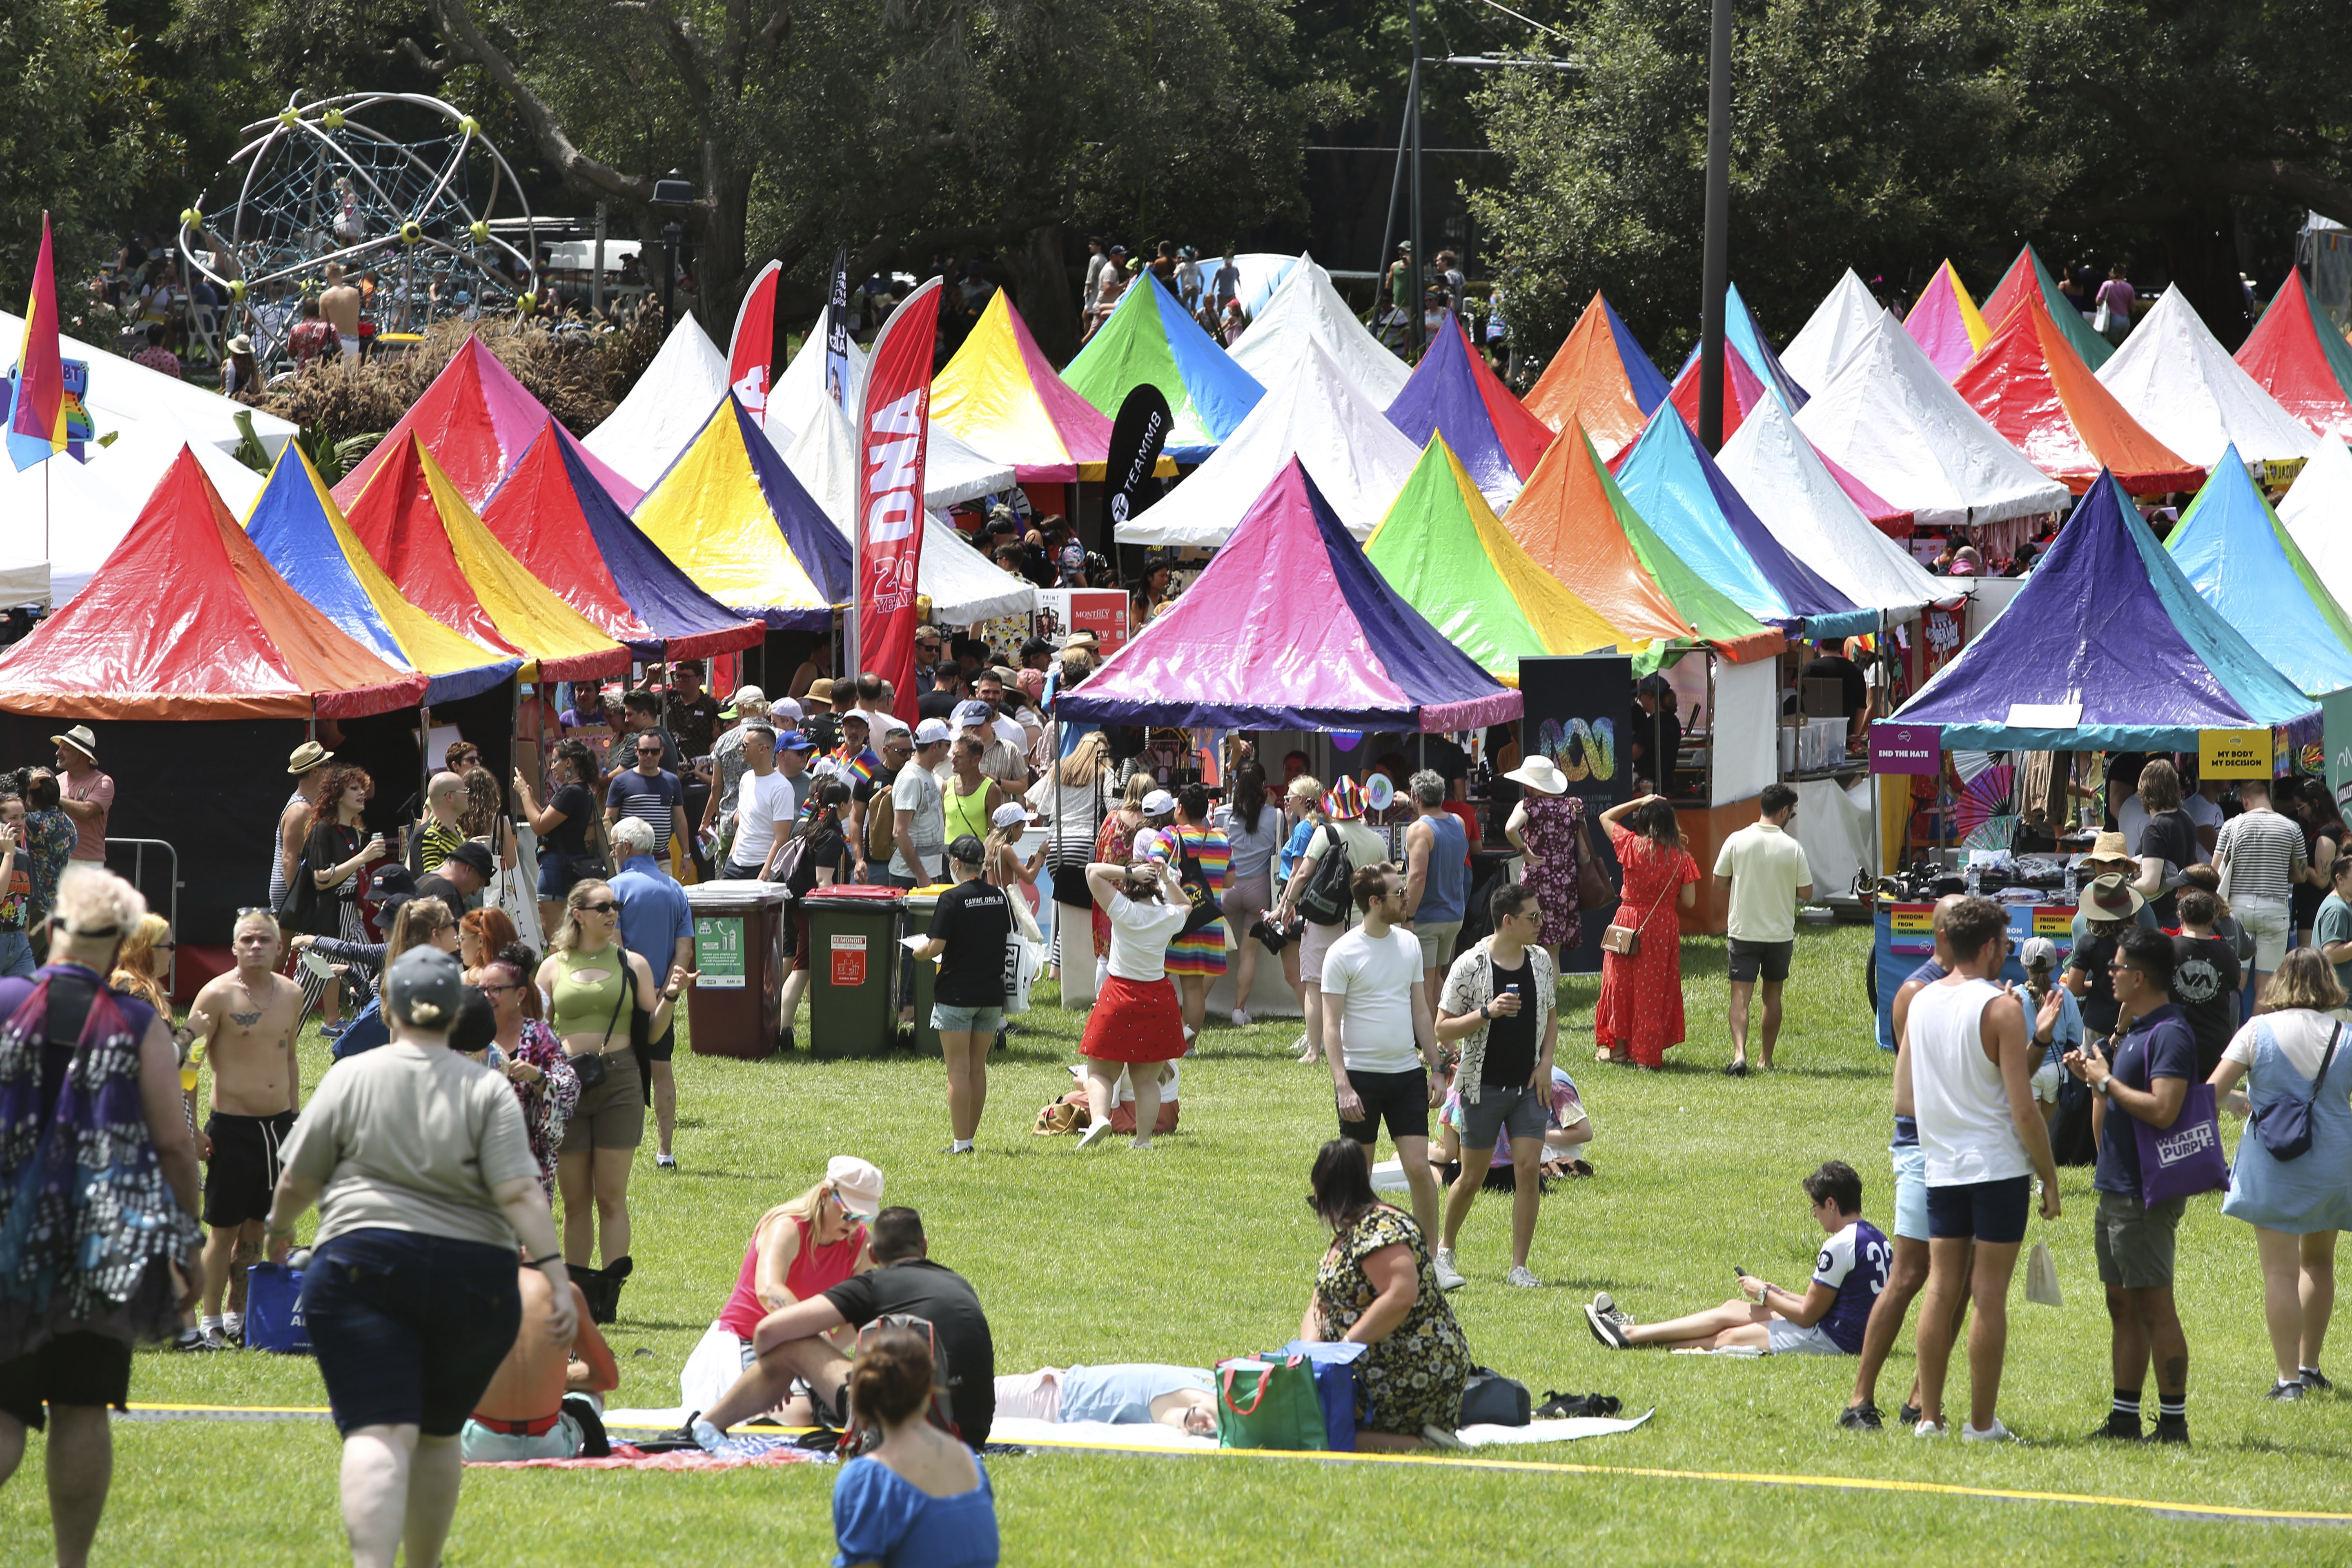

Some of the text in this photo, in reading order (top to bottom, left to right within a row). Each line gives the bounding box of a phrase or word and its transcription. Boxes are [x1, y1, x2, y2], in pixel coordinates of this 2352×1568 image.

[869, 388, 921, 545] DNA
[1124, 411, 1161, 492] TEAMM8
[2156, 1128, 2208, 1147] WEAR IT
[2163, 1136, 2215, 1159] PURPLE
